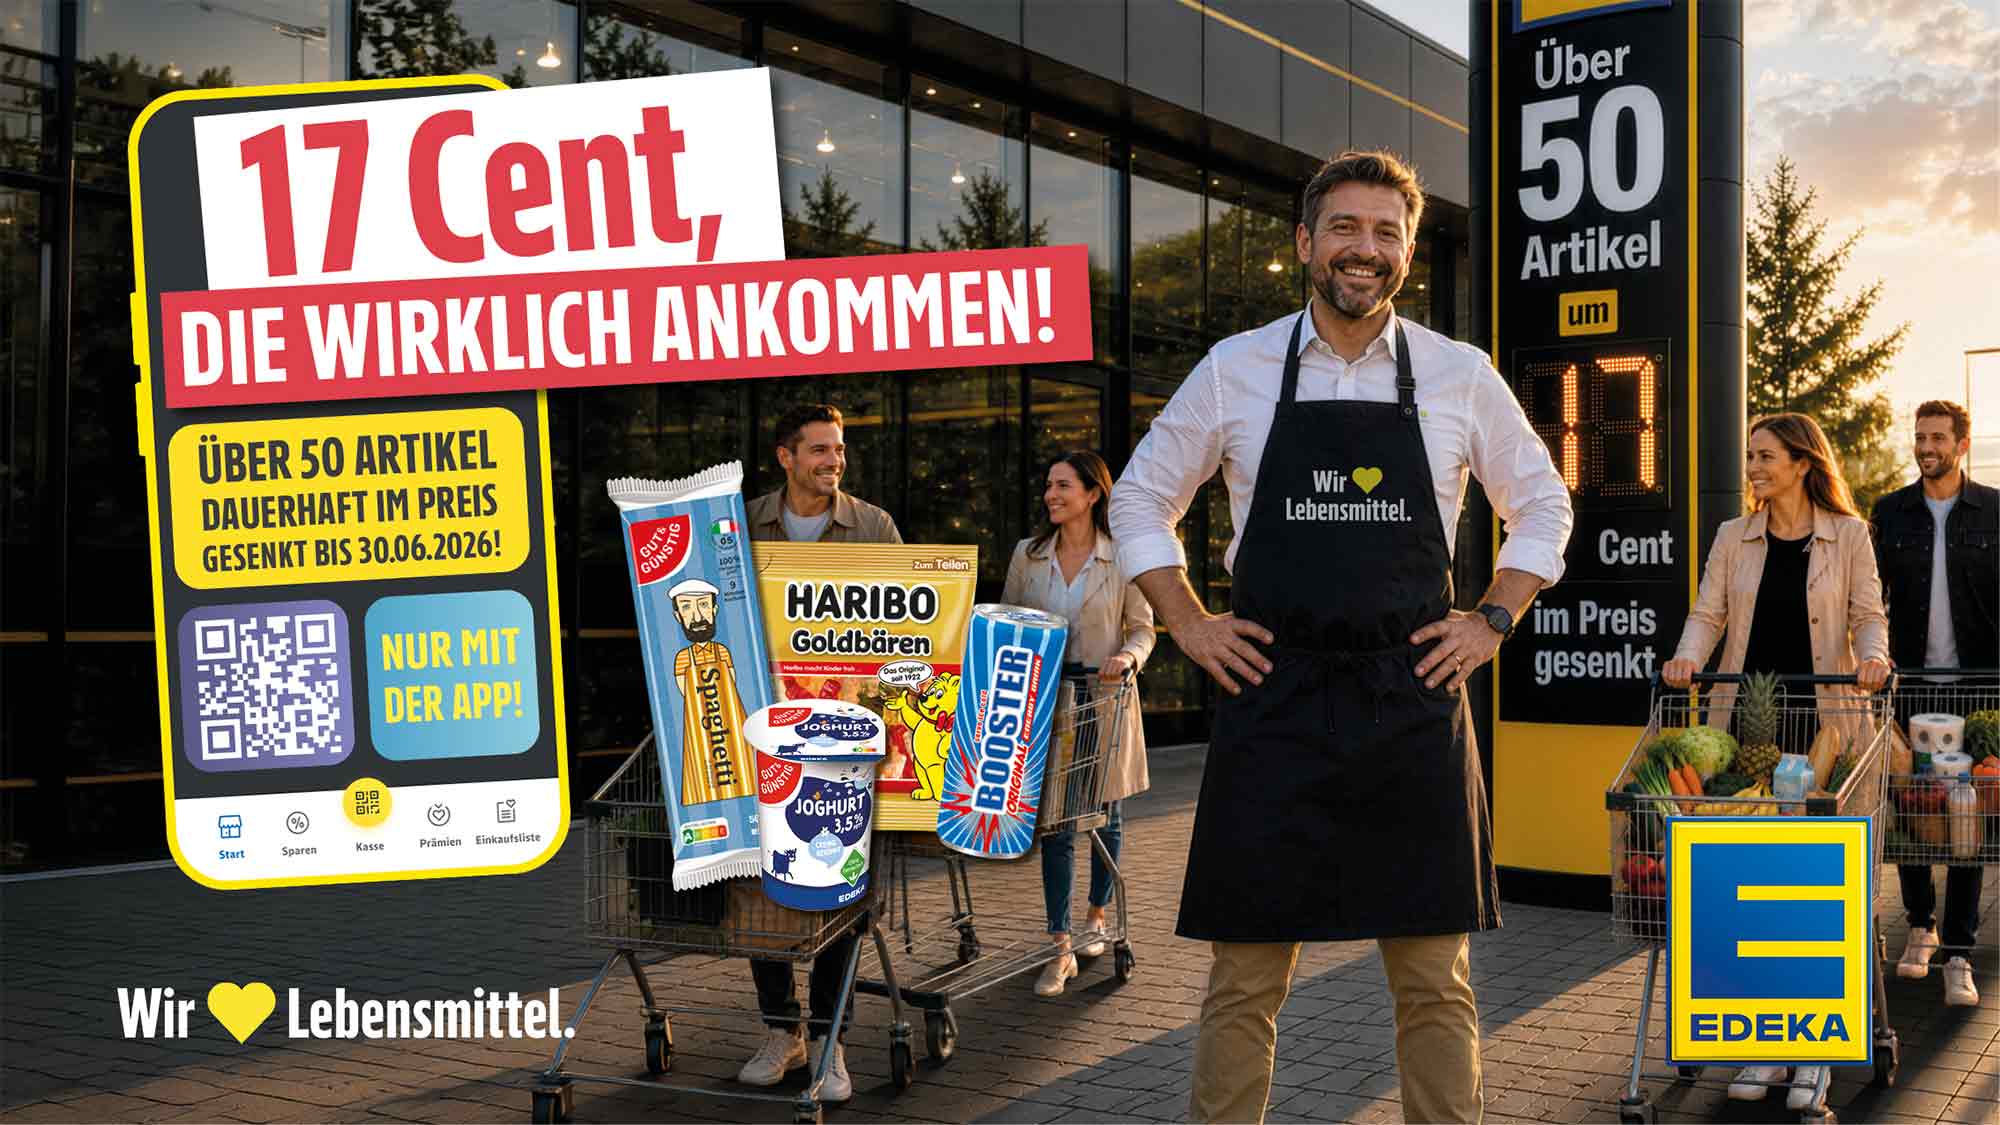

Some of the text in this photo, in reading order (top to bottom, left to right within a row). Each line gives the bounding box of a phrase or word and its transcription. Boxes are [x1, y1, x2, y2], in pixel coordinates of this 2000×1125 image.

[1535, 37, 1631, 90] Über
[1518, 85, 1665, 222] 50
[1520, 219, 1661, 280] Artikel
[1567, 301, 1608, 326] um
[1563, 356, 1655, 490] 17
[1312, 470, 1347, 493] Wir
[1286, 497, 1412, 522] Lebensmittel.
[639, 527, 667, 559] GUT&
[640, 522, 681, 574] GÜNSTIG
[1599, 529, 1673, 565] Cent
[914, 559, 969, 570] Zum Teilen
[786, 583, 937, 621] HARIBO
[1534, 600, 1657, 635] im Preis
[791, 629, 931, 655] Goldbären
[883, 665, 926, 675] Das Original
[1535, 643, 1657, 685] gesenkt
[696, 667, 737, 787] Spaghetti
[801, 723, 872, 731] JOGHURT
[975, 649, 1030, 811] BOOSTER
[760, 764, 794, 795] GÜNSTIG
[1006, 744, 1028, 815] ORIGINAL
[795, 792, 865, 816] JOGHURT
[838, 884, 865, 903] EDEKA
